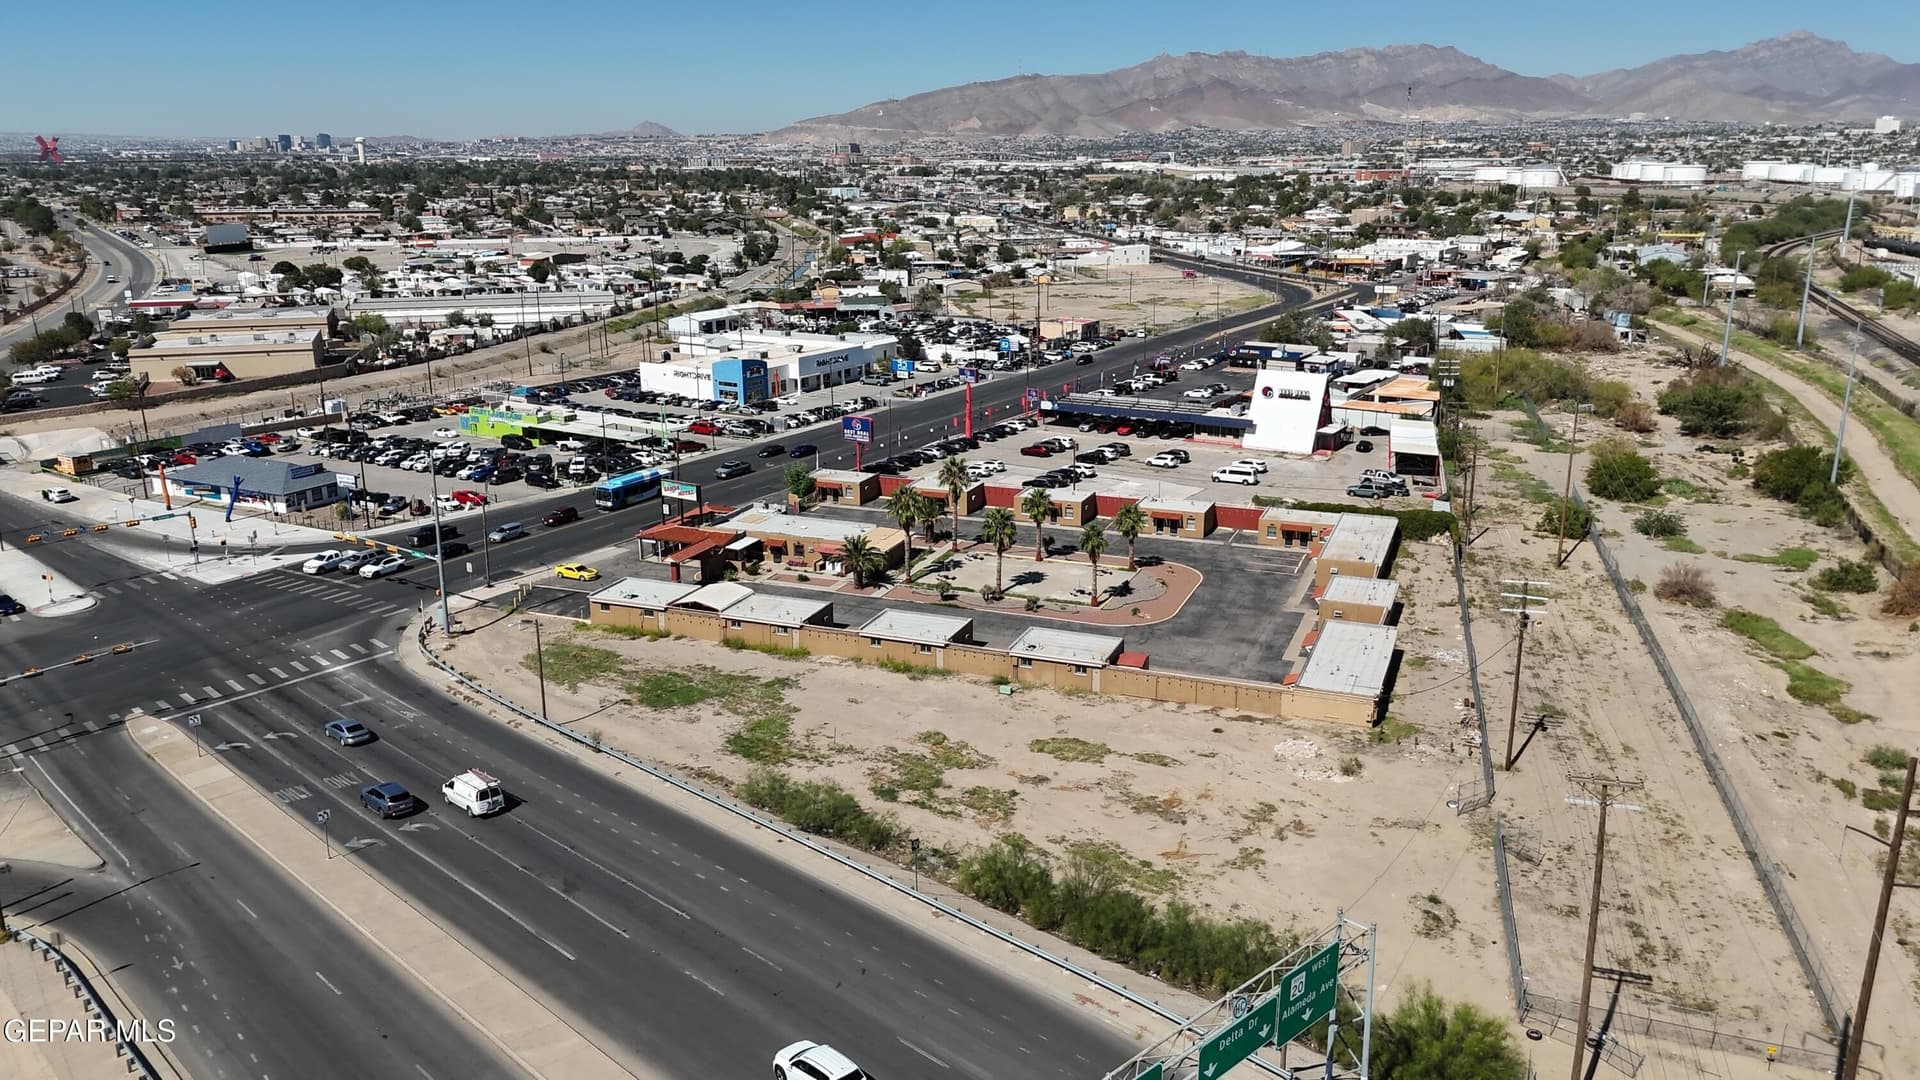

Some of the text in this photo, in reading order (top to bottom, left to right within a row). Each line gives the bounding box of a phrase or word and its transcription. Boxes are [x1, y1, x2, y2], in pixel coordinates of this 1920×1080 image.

[323, 771, 362, 788] ONLY
[273, 785, 312, 803] ONLY
[1311, 954, 1330, 972] WEST
[1292, 980, 1304, 998] 20
[1281, 991, 1317, 1021] Alameda
[1320, 978, 1334, 993] Ave
[1219, 1016, 1258, 1051] Delta Dr
